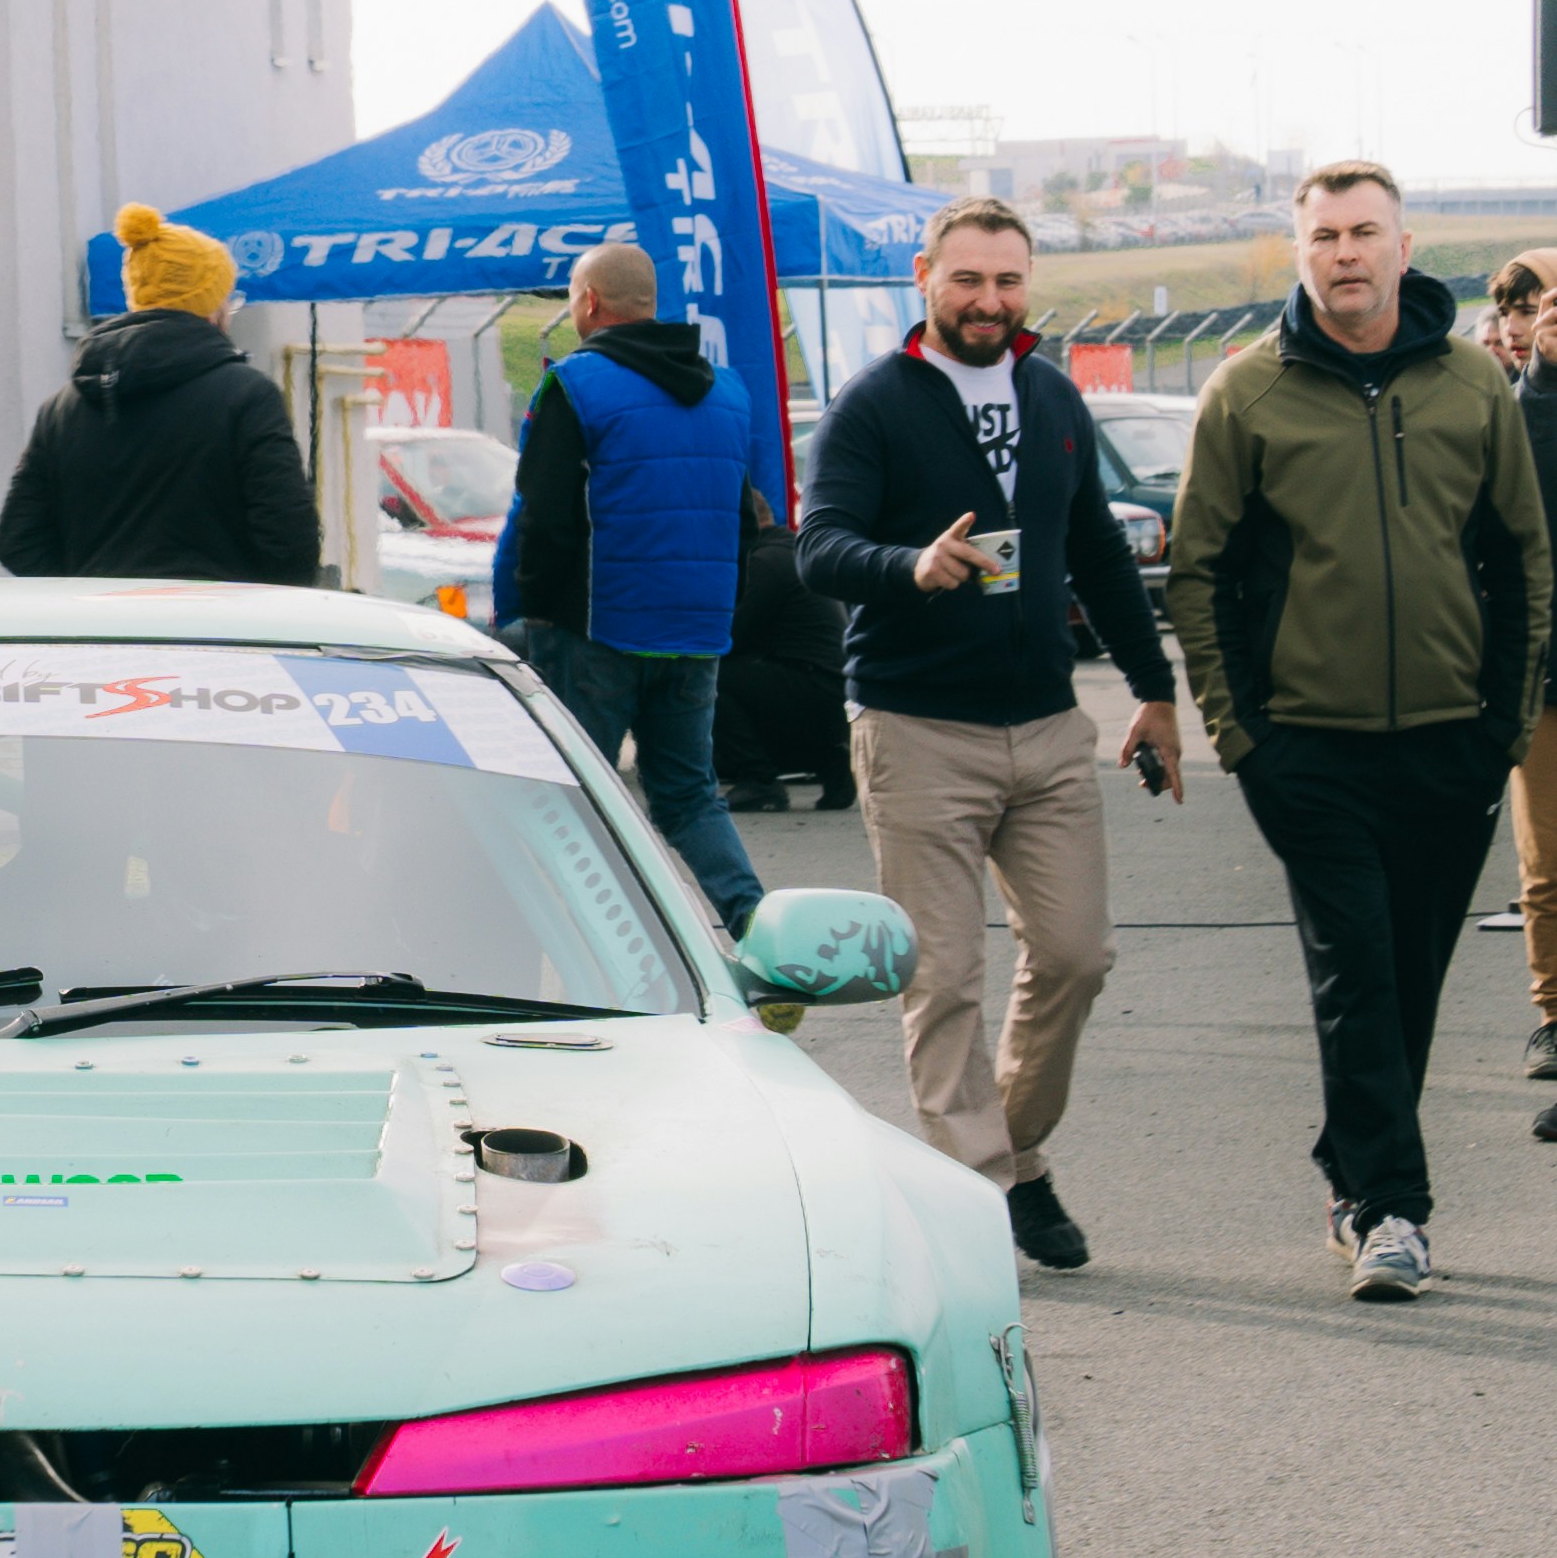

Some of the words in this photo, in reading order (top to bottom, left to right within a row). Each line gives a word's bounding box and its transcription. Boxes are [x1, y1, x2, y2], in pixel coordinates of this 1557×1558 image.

[291, 221, 639, 266] TRI-ACE
[22, 660, 57, 686] by
[314, 689, 439, 727] 234
